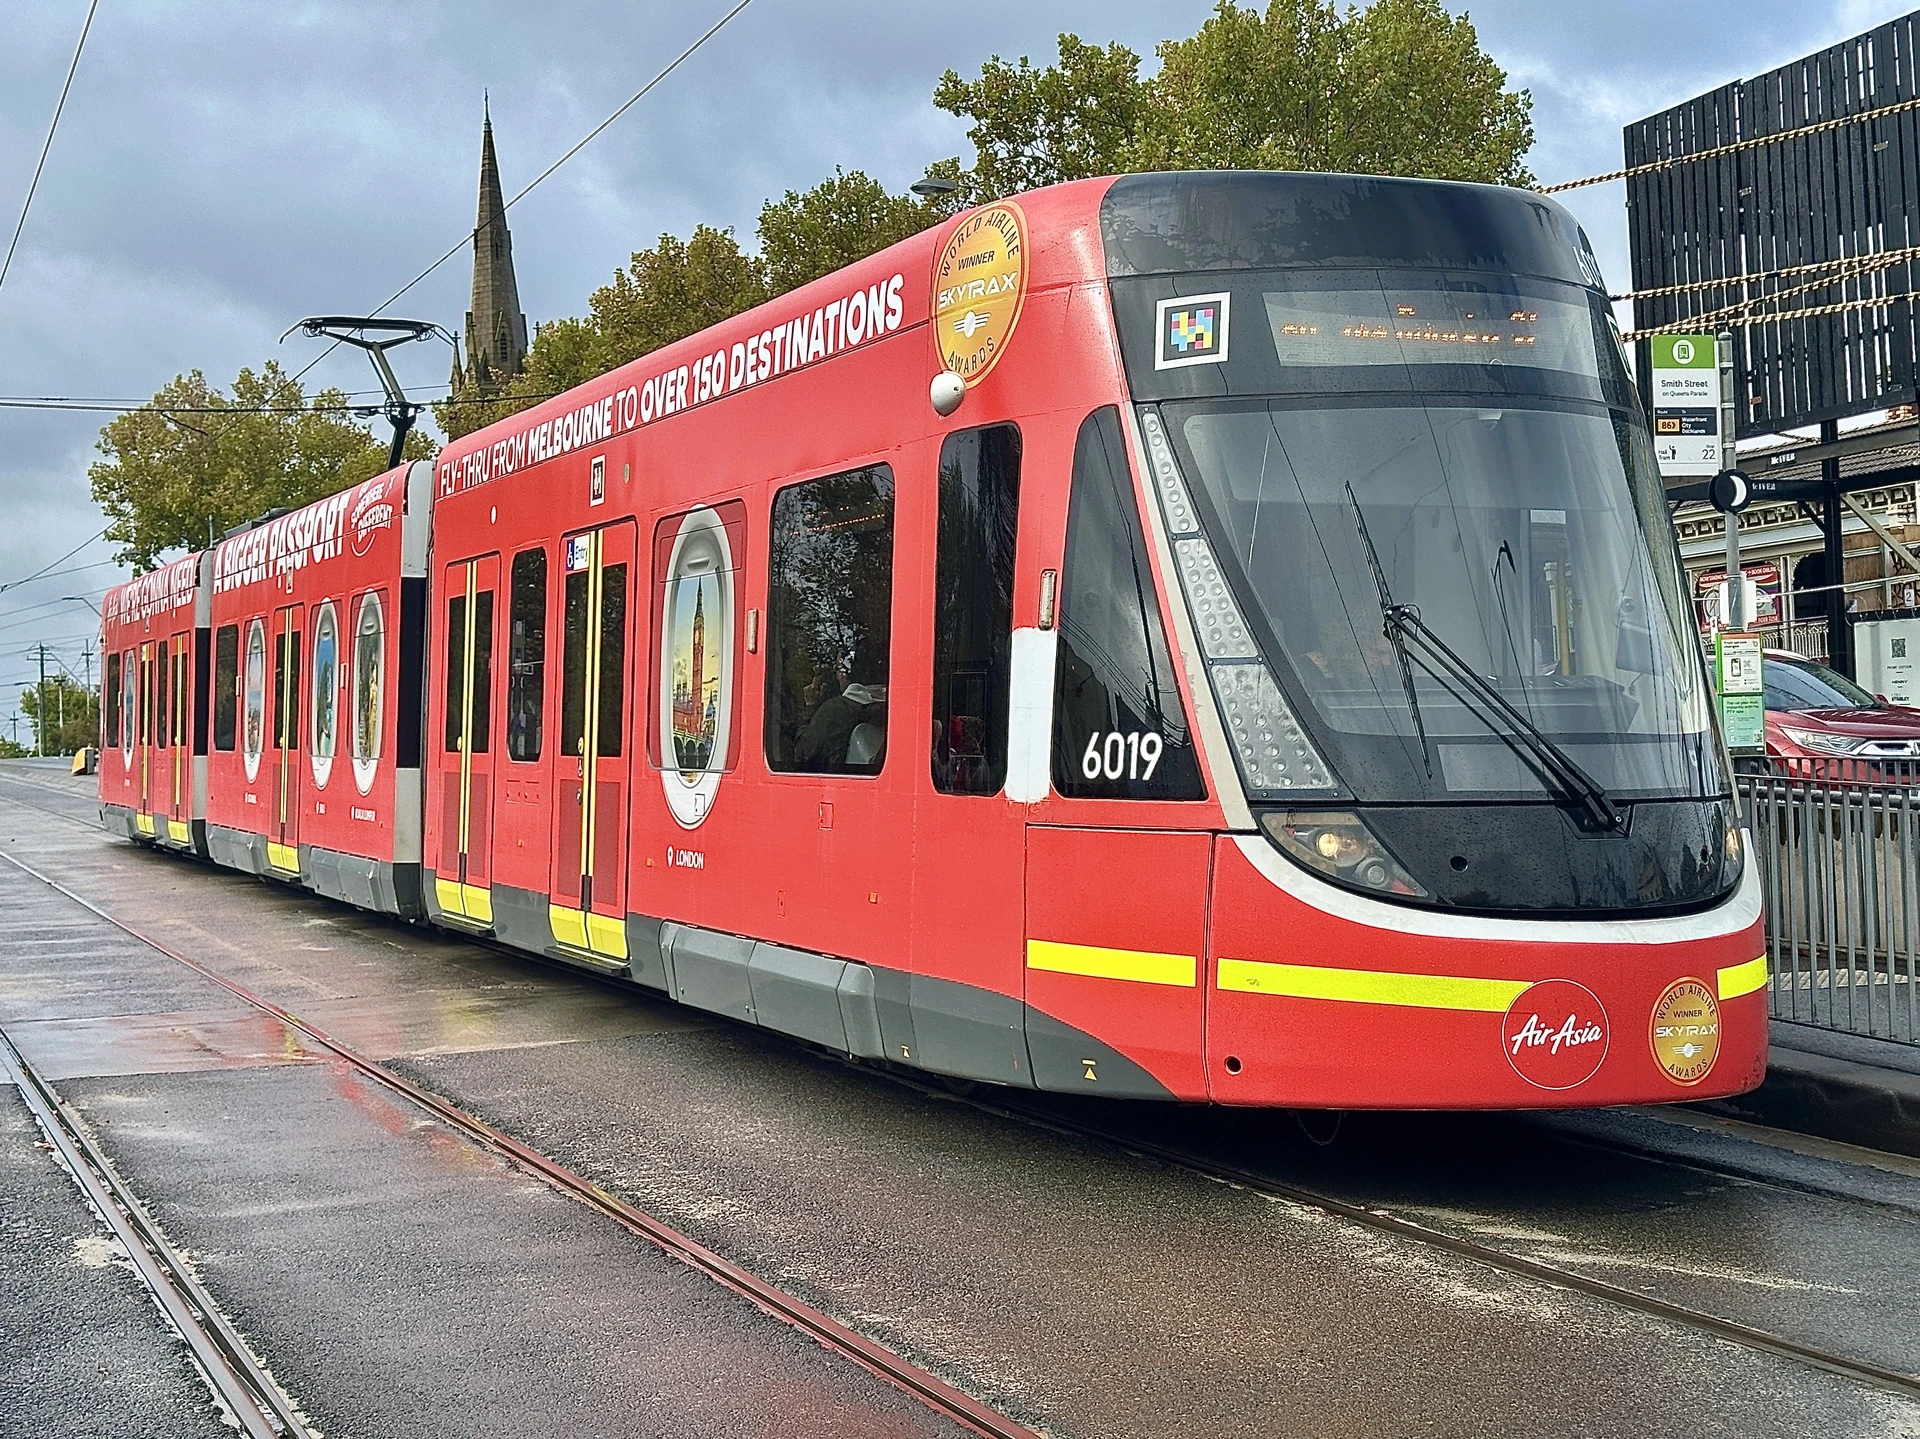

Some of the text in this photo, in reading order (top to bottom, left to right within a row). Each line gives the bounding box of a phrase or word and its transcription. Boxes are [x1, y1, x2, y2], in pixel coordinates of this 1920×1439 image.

[941, 211, 1019, 277] WORLD AIRLINE
[957, 250, 995, 271] WINNER
[938, 271, 1018, 309] SKYTRAX
[947, 336, 995, 375] AWARDS
[440, 272, 904, 498] FLY-THRU FROM MELBOURNE TO OVER 150 DESTINATIONS
[1661, 380, 1708, 388] Smith Street
[1702, 449, 1716, 460] 22
[213, 490, 352, 594] A BIGGER PASSPORT
[1906, 592, 1912, 601] 2
[1082, 731, 1163, 781] 6019
[676, 849, 705, 870] LONDON
[1657, 986, 1717, 1020] WORLD AIRLINE
[1673, 1009, 1703, 1018] WINNER
[1511, 1013, 1603, 1055] AirAsia
[1655, 1023, 1718, 1038] SKYTRAX
[1668, 1058, 1708, 1078] AWARDS
